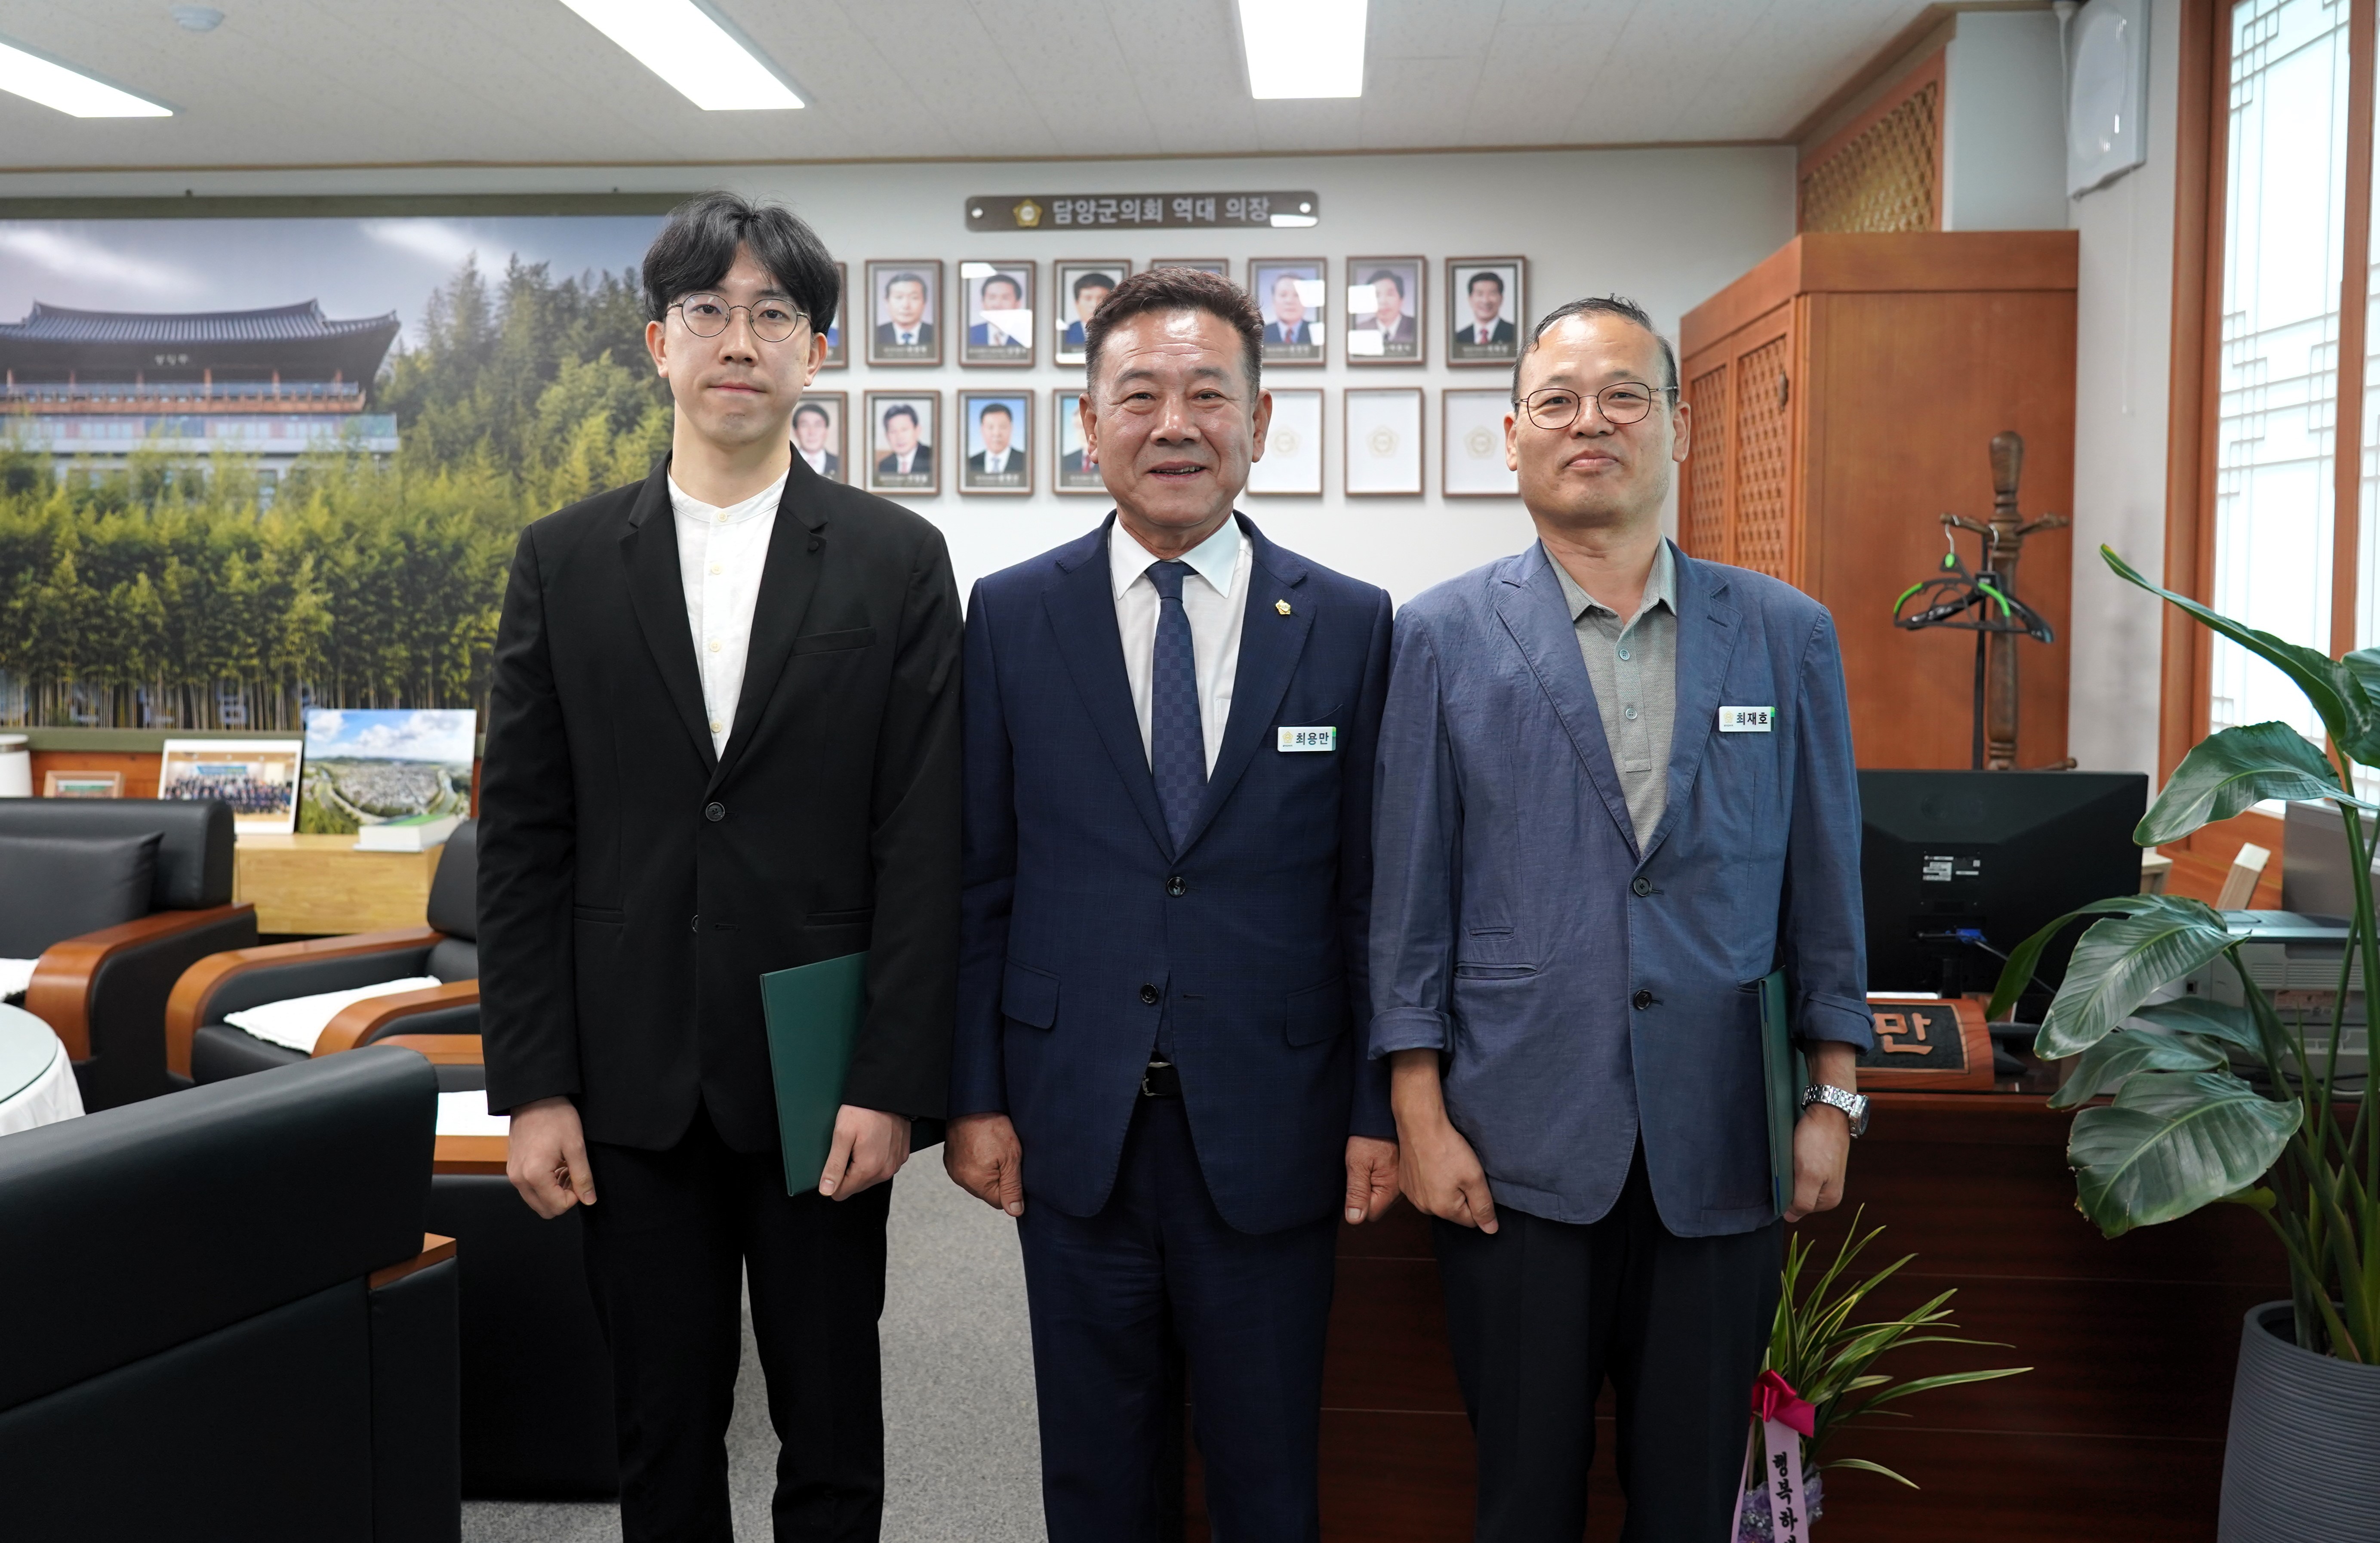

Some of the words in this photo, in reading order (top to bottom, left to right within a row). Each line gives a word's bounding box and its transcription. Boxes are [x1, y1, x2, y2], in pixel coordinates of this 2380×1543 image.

[1053, 198, 1163, 225] 담양군의회
[1172, 197, 1216, 222] 역대
[1225, 195, 1270, 222] 의장
[1737, 712, 1767, 725] 최재호
[1296, 732, 1329, 745] 최용만
